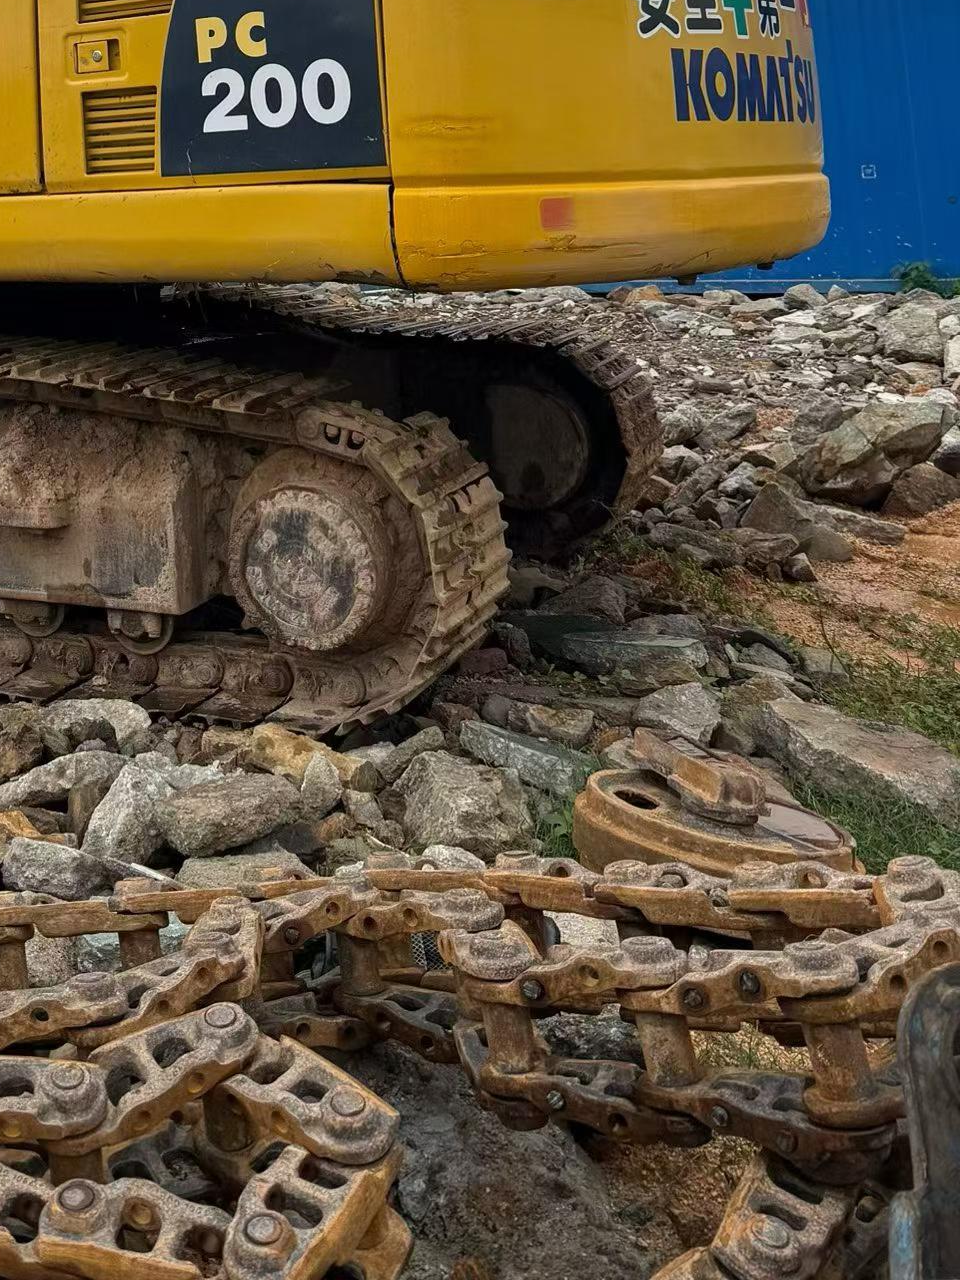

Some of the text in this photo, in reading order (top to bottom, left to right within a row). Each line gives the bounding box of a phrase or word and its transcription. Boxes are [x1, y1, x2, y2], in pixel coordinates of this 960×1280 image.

[195, 11, 268, 63] PC
[200, 58, 351, 133] 200
[670, 39, 816, 124] KOMATSU
